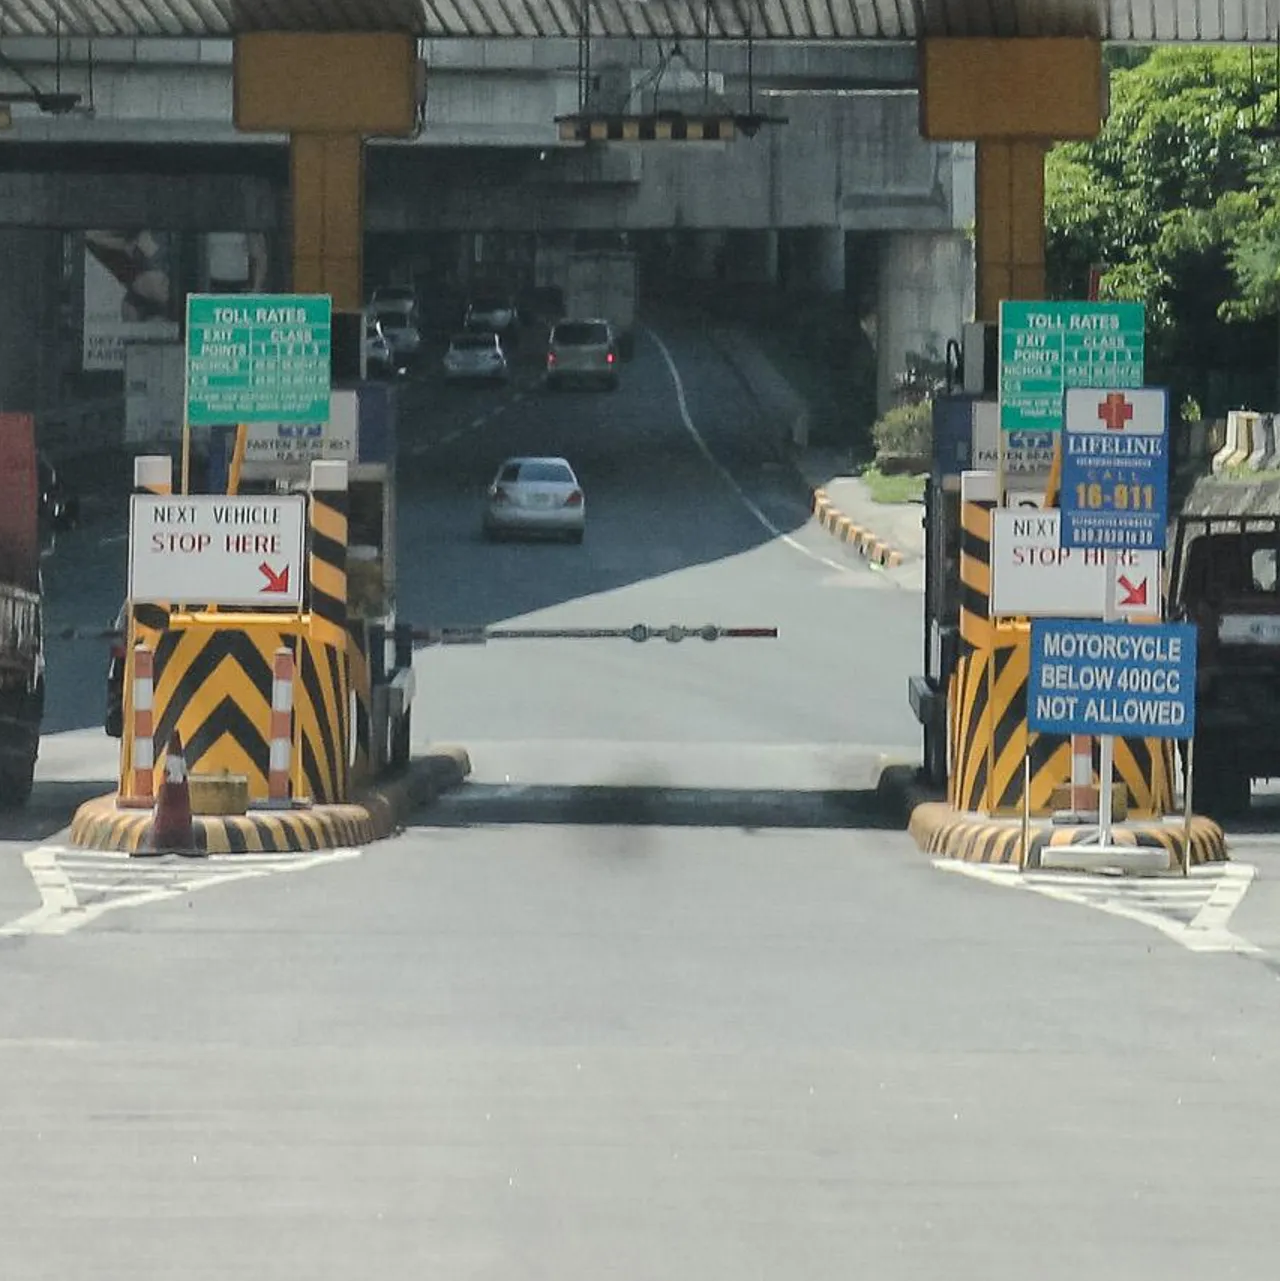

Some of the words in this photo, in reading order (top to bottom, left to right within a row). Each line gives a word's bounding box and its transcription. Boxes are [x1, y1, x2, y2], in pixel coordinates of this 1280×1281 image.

[214, 307, 251, 324] TOLL
[256, 307, 307, 324] RATES
[1026, 313, 1065, 329] TOLL
[1070, 314, 1120, 330] RATES
[1067, 435, 1163, 457] LIFELINE
[153, 506, 196, 523] NEXT
[213, 506, 281, 524] VEHICLE
[1013, 519, 1055, 537] NEXT
[151, 533, 211, 554] STOP
[225, 533, 282, 554] HERE
[1012, 546, 1072, 567] STOP
[1043, 631, 1182, 663] MOTORCYCLE
[1040, 663, 1115, 692] BELOW
[1117, 667, 1181, 695] 400CC
[1036, 695, 1079, 721] NOT
[1084, 697, 1186, 726] ALLOWED
